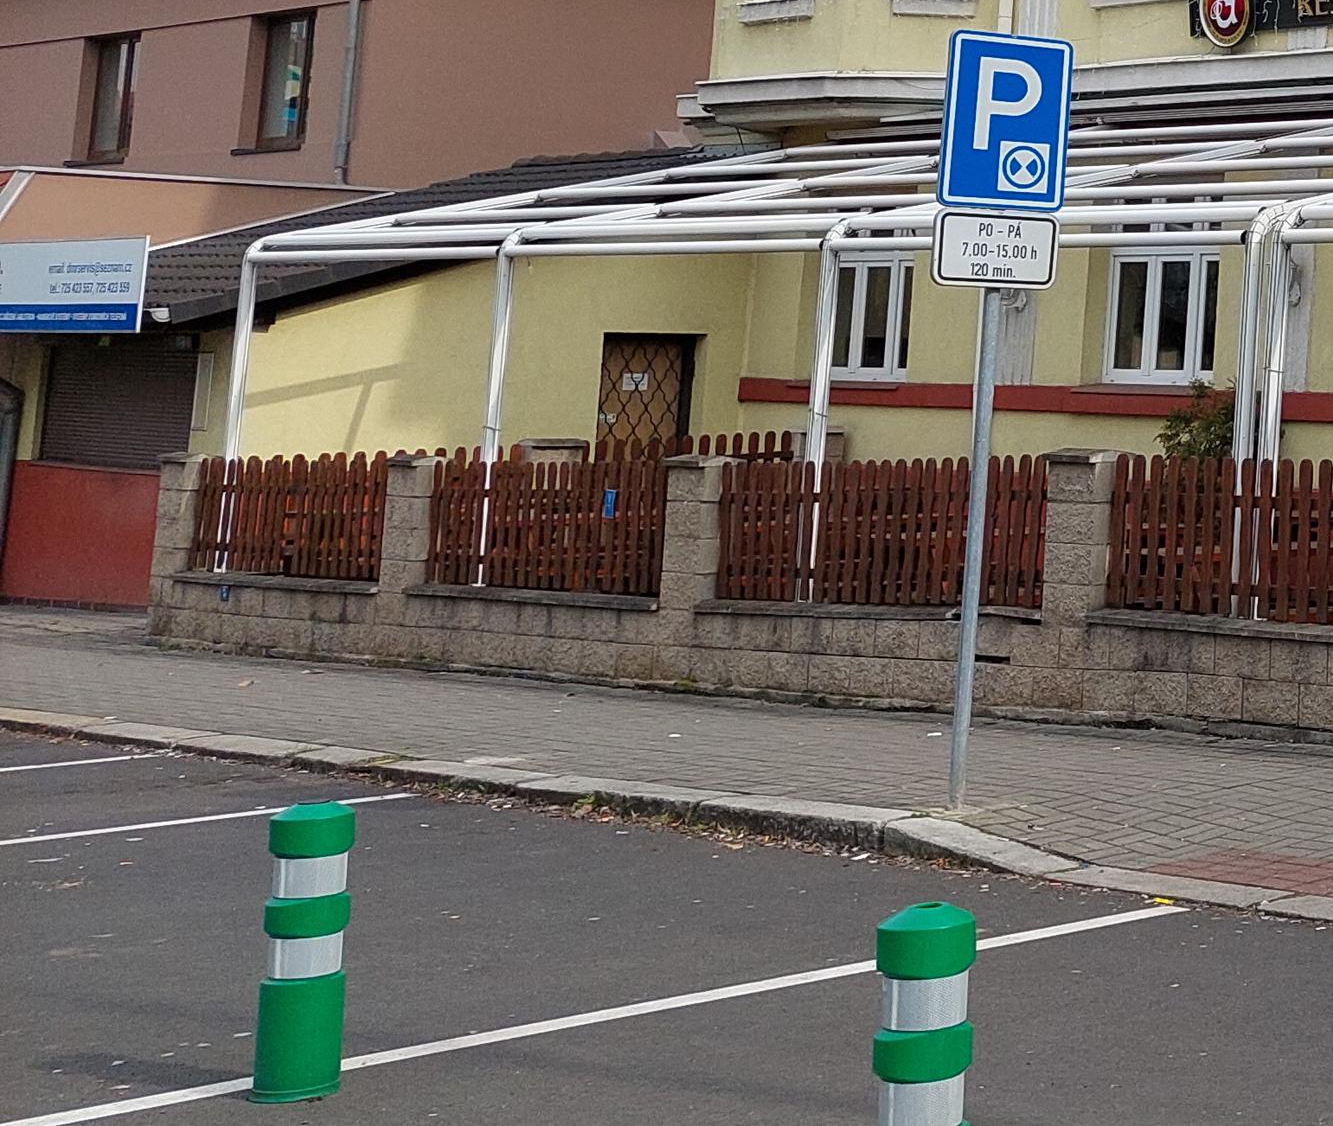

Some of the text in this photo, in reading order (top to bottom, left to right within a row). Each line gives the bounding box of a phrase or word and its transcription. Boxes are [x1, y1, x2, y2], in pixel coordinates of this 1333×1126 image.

[973, 56, 1043, 150] P
[978, 222, 994, 237] PO
[1007, 221, 1022, 239] PÁ
[1030, 244, 1037, 260] h
[970, 262, 1016, 278] 120 min.
